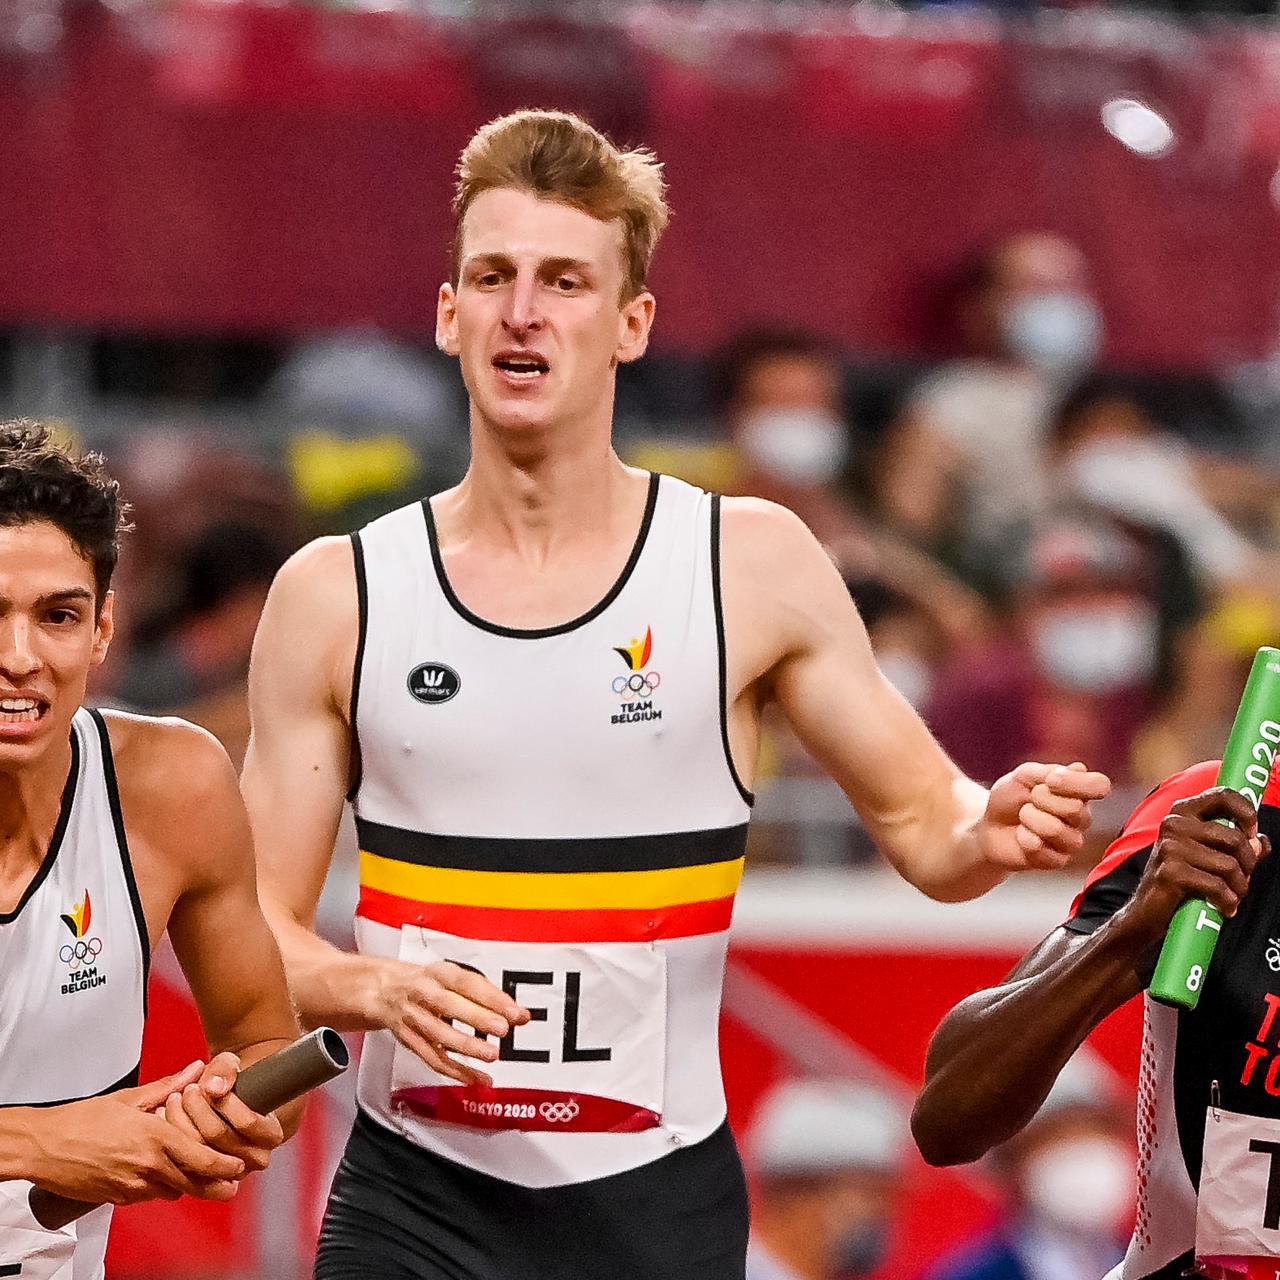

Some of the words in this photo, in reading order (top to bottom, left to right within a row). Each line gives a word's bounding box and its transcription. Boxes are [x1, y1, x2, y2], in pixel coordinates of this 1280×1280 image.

[620, 700, 653, 713] TEAM
[611, 710, 663, 725] BELGIUM
[69, 966, 98, 983] TEAM
[1186, 964, 1203, 992] 8
[61, 975, 107, 995] BELGIUM
[444, 958, 612, 1063] EL
[463, 1100, 503, 1117] TOKYO
[503, 1104, 536, 1119] 2020
